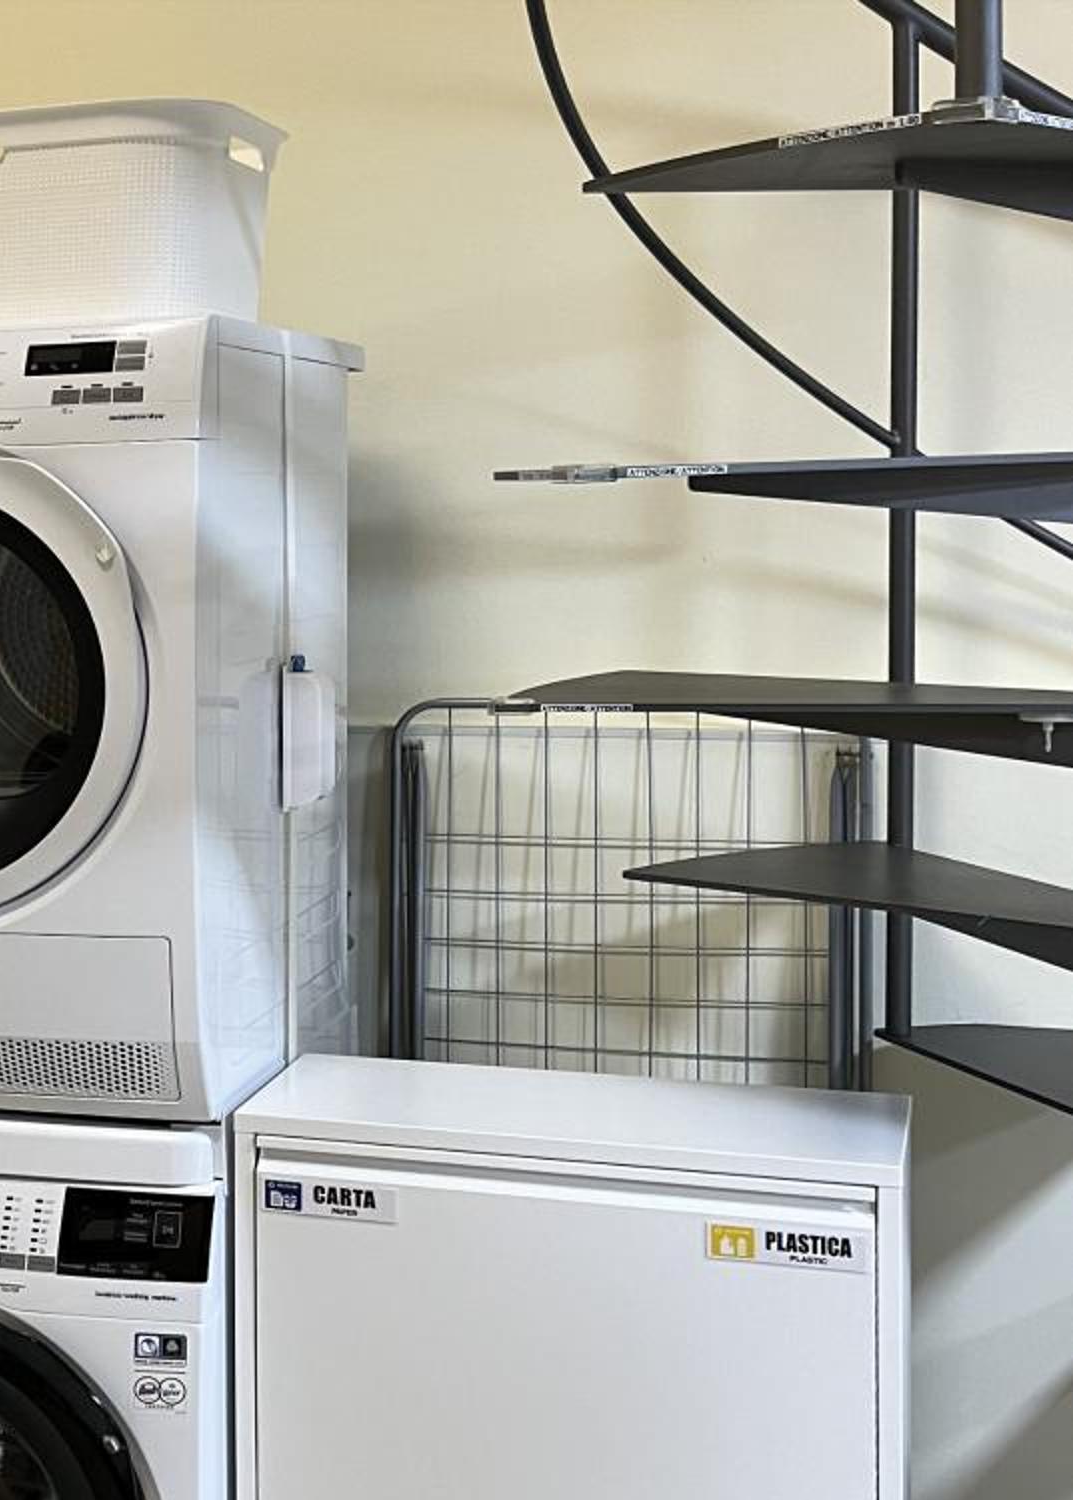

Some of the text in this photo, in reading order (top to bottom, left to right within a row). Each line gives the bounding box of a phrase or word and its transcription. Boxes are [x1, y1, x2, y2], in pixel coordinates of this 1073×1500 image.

[313, 1185, 376, 1209] CARTA
[765, 1231, 853, 1258] PLASTICA
[789, 1255, 828, 1266] PLASTIC
